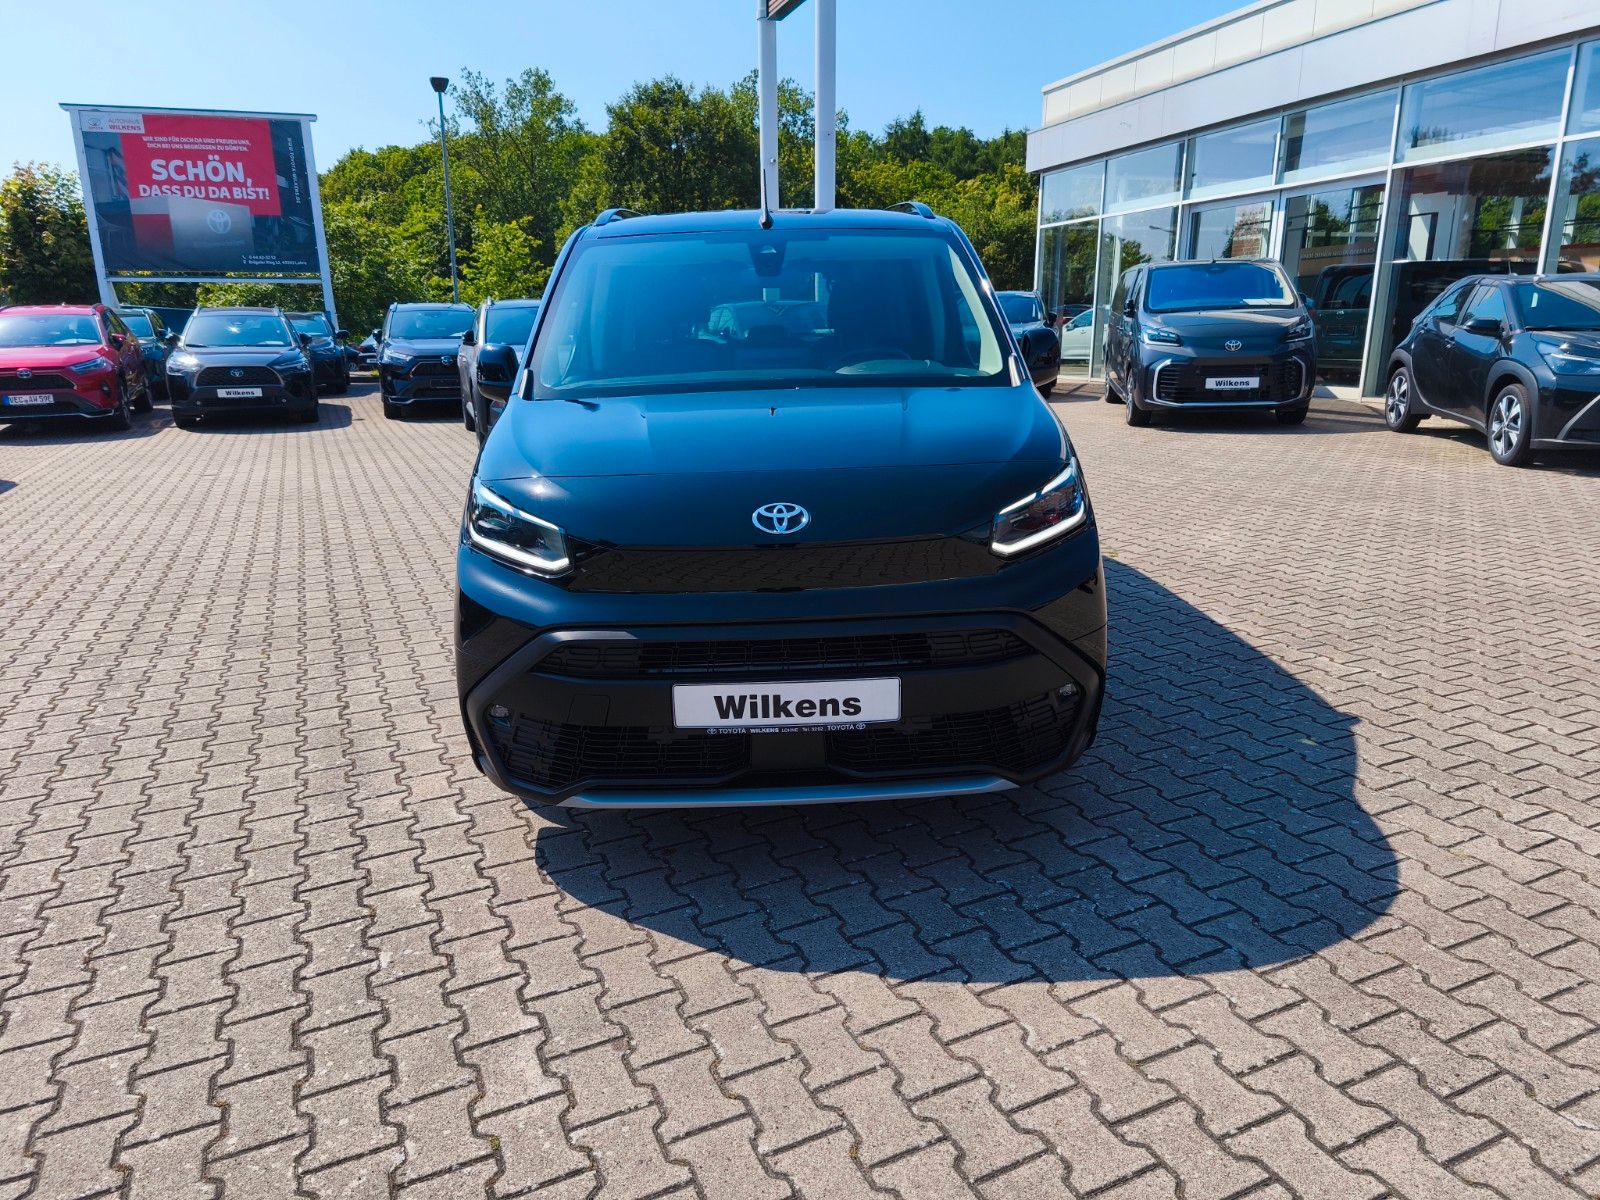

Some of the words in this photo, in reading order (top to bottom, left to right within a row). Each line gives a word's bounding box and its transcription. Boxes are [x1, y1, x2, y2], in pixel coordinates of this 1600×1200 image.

[150, 154, 252, 188] SCHÖN,
[139, 184, 181, 198] DASS
[183, 185, 206, 198] DU
[208, 186, 231, 199] DA
[232, 187, 270, 200] BIST!
[713, 694, 862, 720] Wilkens
